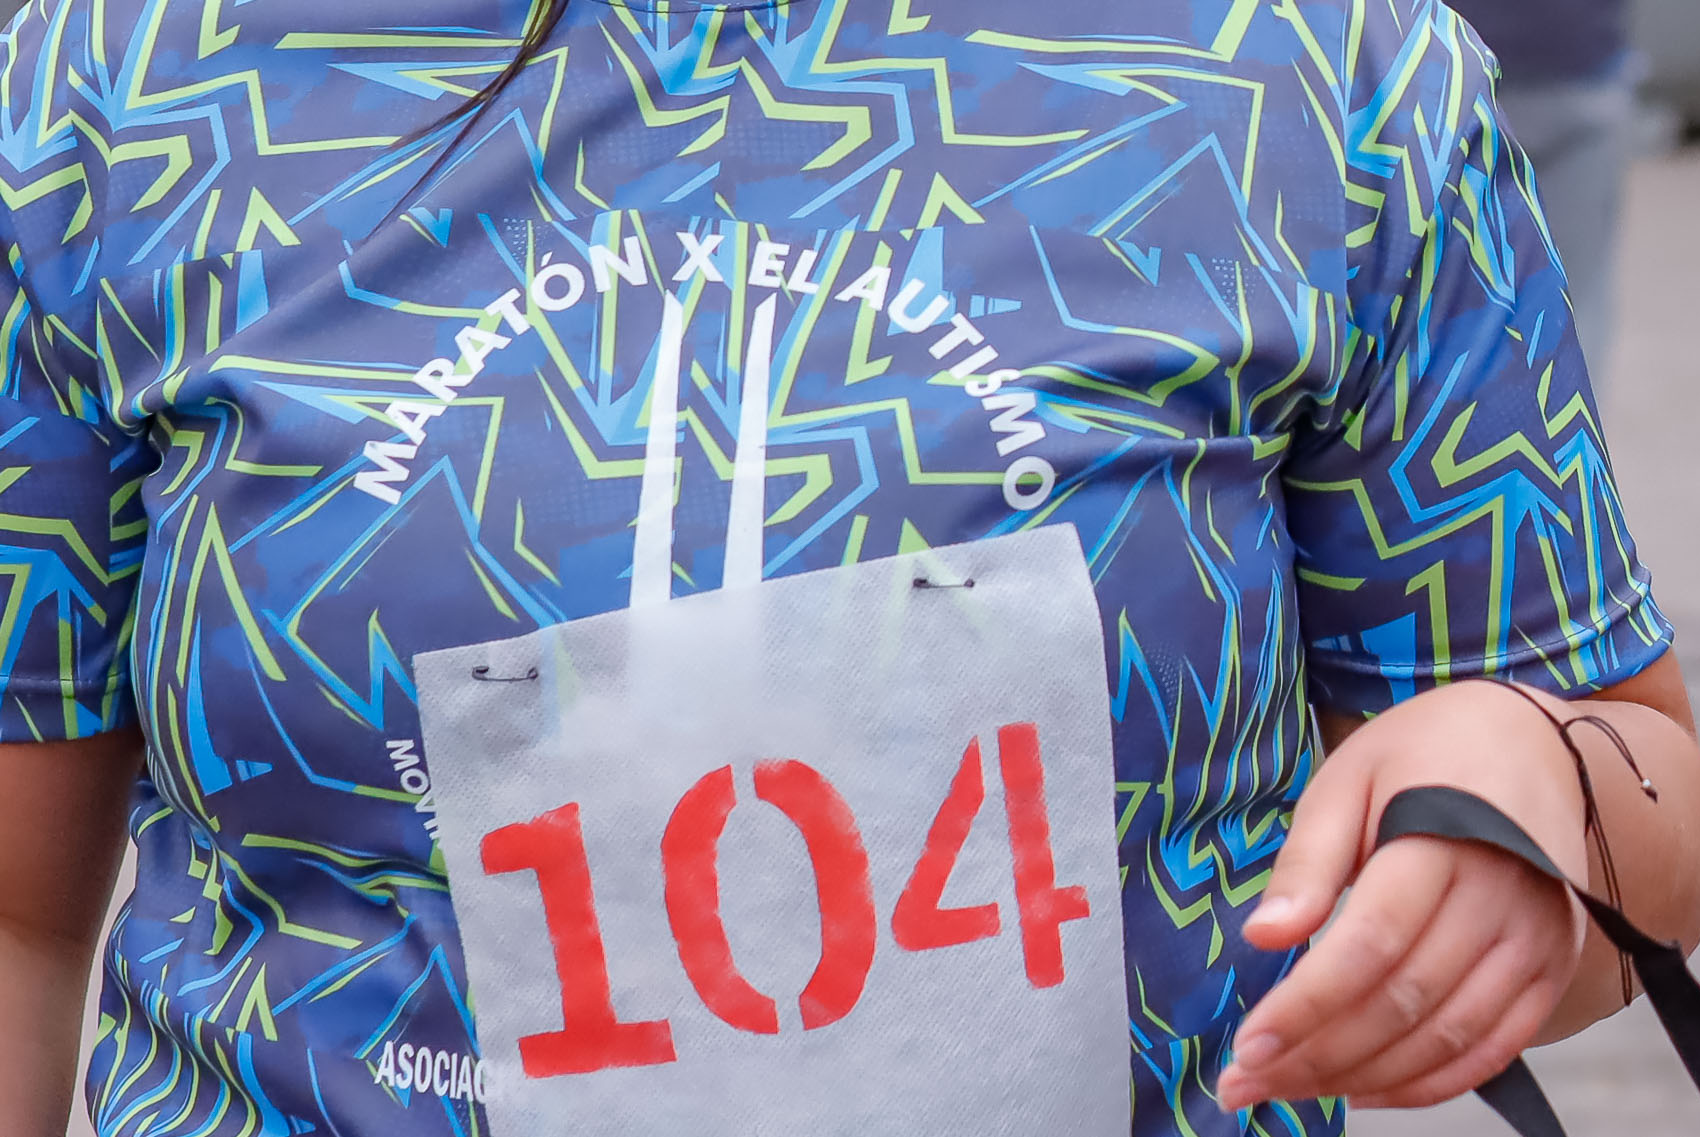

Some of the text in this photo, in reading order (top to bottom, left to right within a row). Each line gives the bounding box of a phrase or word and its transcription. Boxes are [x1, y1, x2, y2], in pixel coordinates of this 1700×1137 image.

[353, 231, 1057, 512] MARATÓN X EL AUTISMO
[479, 721, 1091, 1079] 104
[374, 1040, 487, 1105] ASOCIAC
